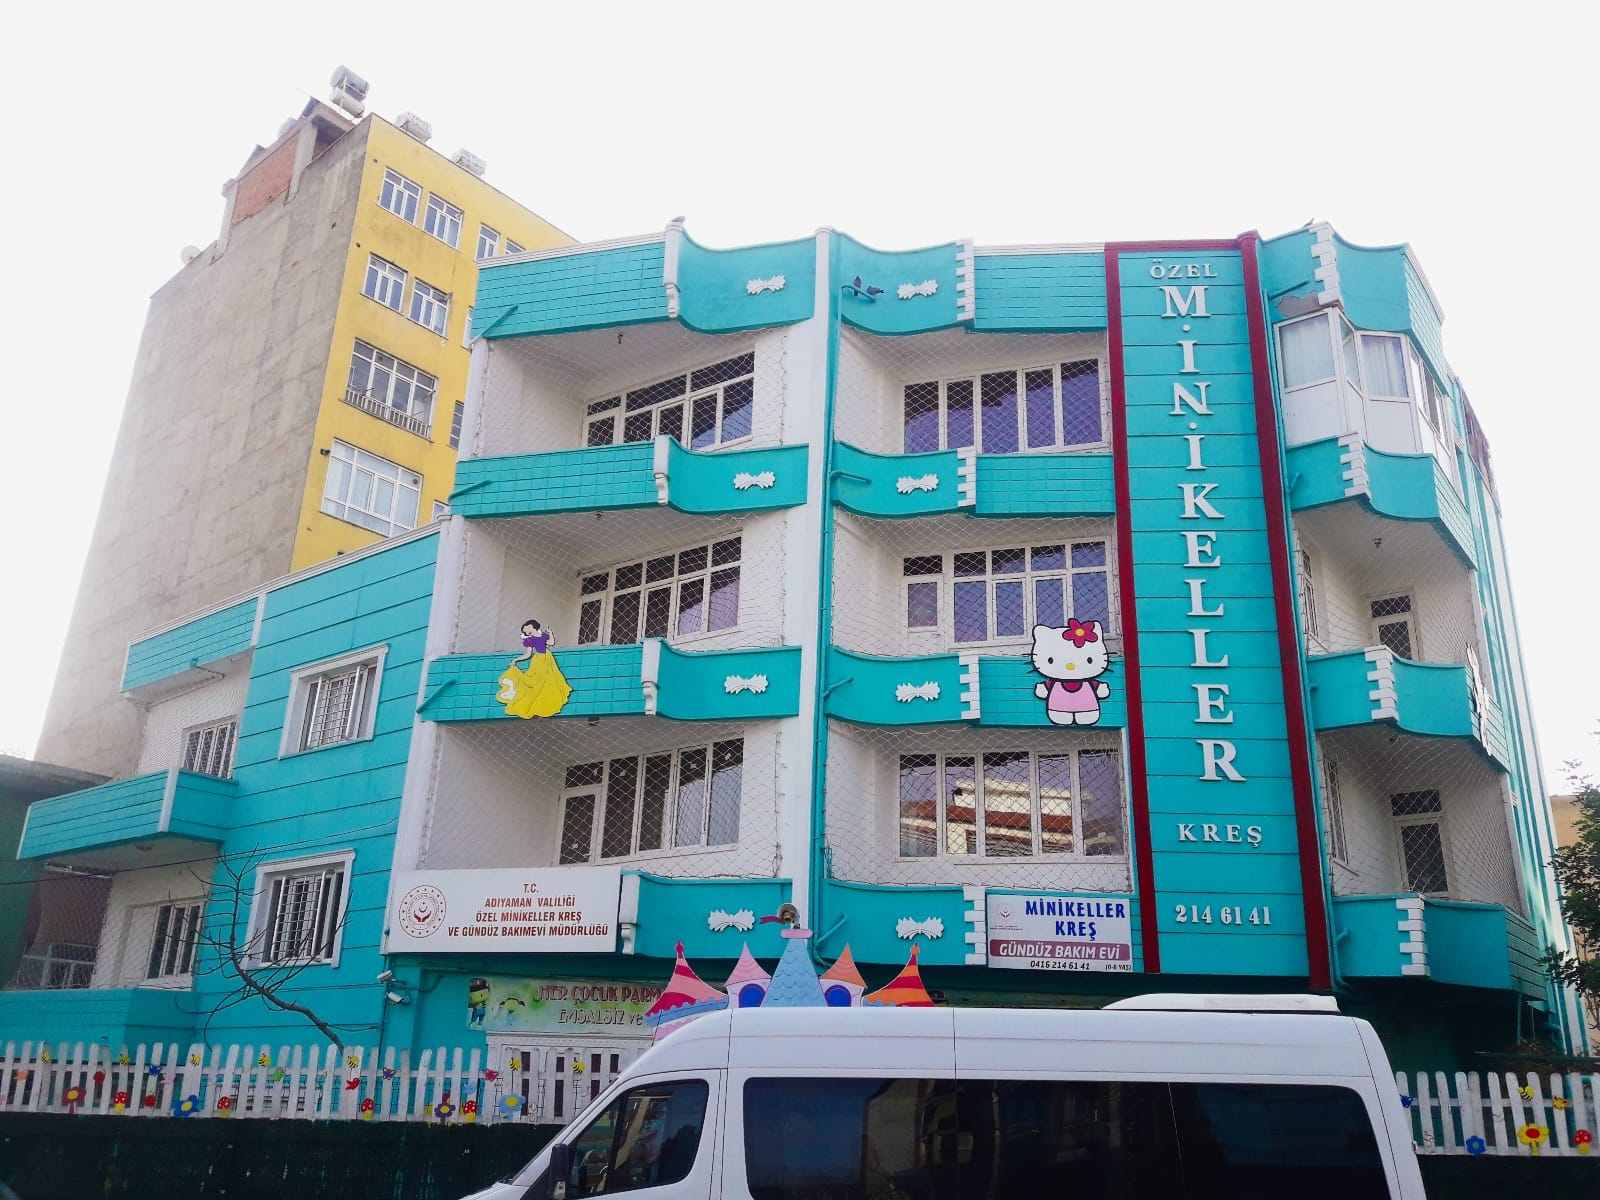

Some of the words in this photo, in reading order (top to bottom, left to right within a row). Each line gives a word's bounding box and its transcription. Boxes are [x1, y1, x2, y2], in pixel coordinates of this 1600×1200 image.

[1150, 259, 1218, 279] ÖZEL
[1160, 285, 1247, 782] MİNİKELLER
[1177, 823, 1262, 848] KREŞ
[523, 883, 539, 894] T.C.
[485, 898, 532, 908] ADIYAMAN
[537, 895, 576, 907] VALİLİĞİ
[1025, 898, 1126, 919] MİNİKELLER
[475, 910, 498, 923] ÖZEL
[501, 910, 556, 922] MİNİKELLER
[558, 911, 582, 924] KREŞ
[1175, 904, 1213, 924] 214
[1220, 906, 1242, 925] 61
[1248, 906, 1271, 925] 41
[448, 926, 460, 937] VE
[461, 924, 499, 937] GÜNDÜZ
[501, 924, 547, 937] BAKIMEVİ
[548, 924, 609, 937] MÜDÜRLÜĞÜ
[1055, 921, 1097, 941] KREŞ
[999, 941, 1054, 958] GÜNDÜZ
[1055, 944, 1096, 959] BAKIM
[1099, 945, 1120, 960] EVİ
[1030, 960, 1051, 969] 0416
[1052, 961, 1067, 970] 214
[1069, 961, 1079, 970] 61
[1080, 962, 1090, 971] 41
[539, 985, 568, 1001] HER
[572, 985, 618, 1005] ÇOCUK
[622, 986, 663, 1004] PARM
